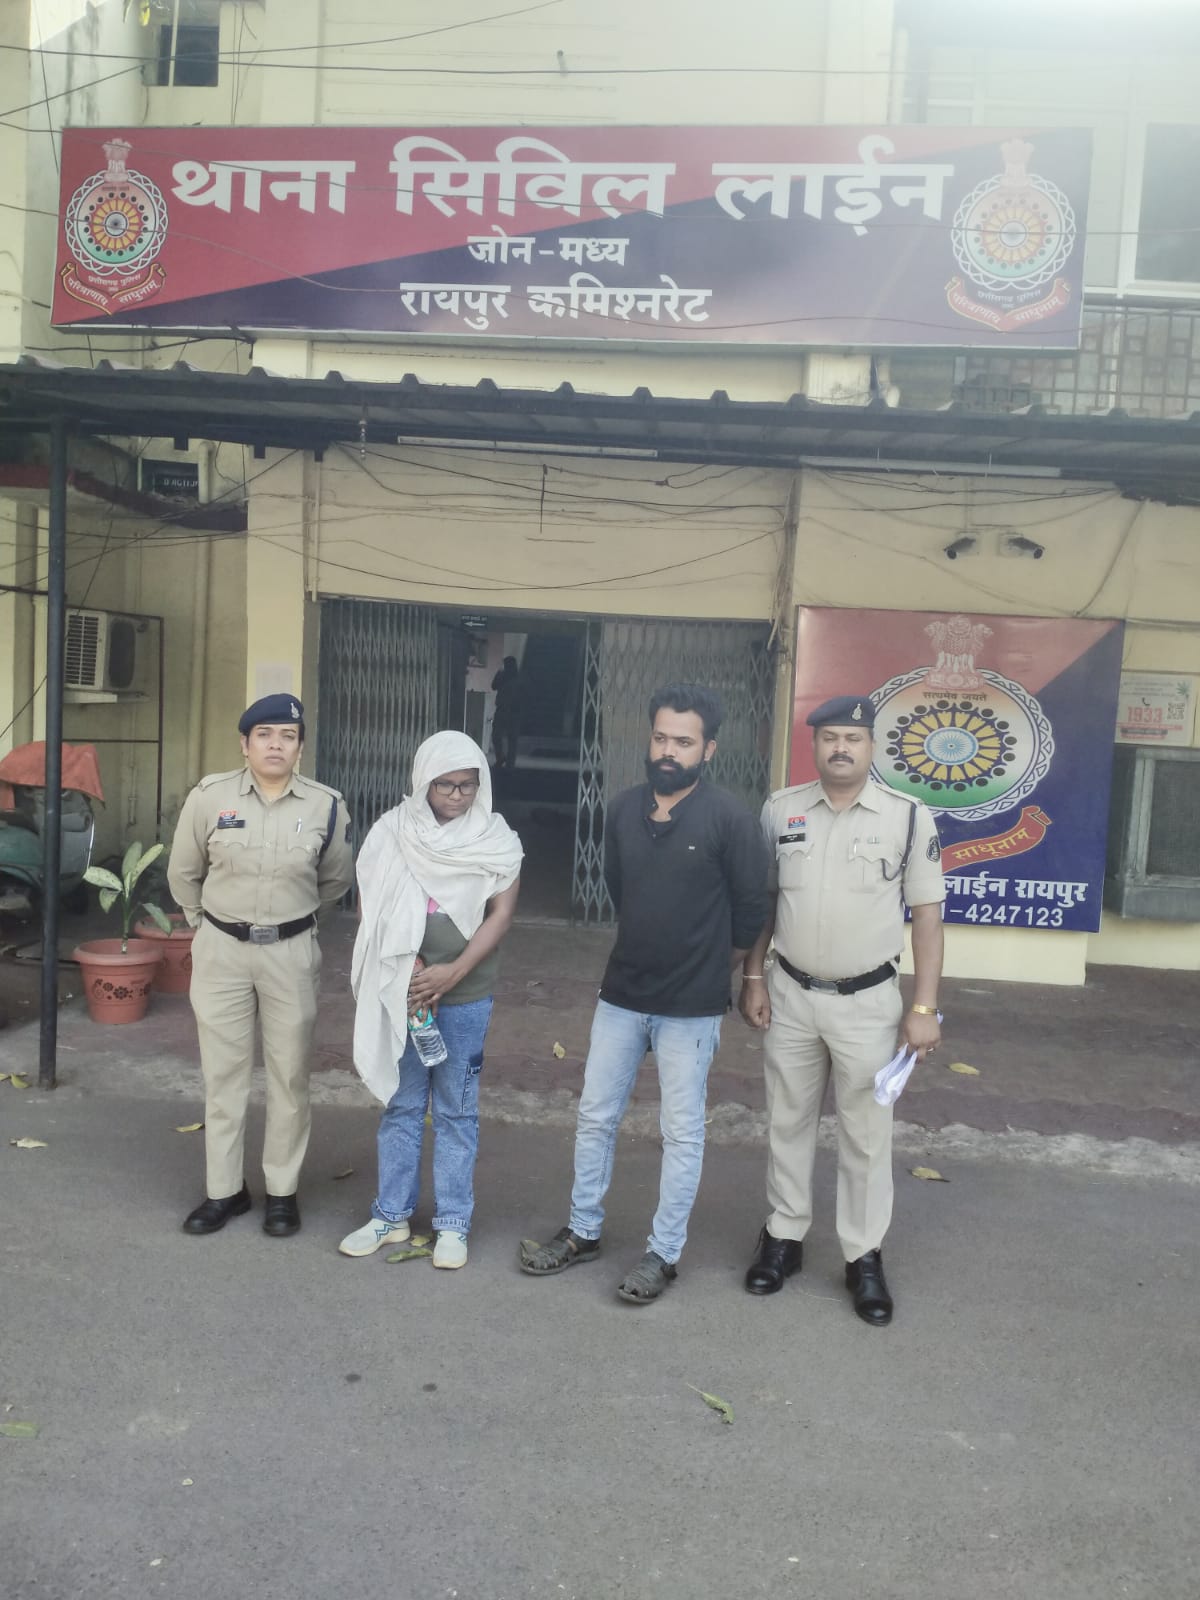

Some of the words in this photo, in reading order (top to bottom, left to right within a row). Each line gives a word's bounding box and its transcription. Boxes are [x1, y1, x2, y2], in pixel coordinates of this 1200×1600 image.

[170, 160, 356, 214] थाना
[389, 136, 676, 219] सिविल
[712, 135, 954, 236] लाईन
[400, 282, 511, 331] रायपुर
[527, 272, 712, 323] कमिश्नरेट
[1128, 706, 1163, 723] 1933
[1015, 879, 1088, 908] रायपुर
